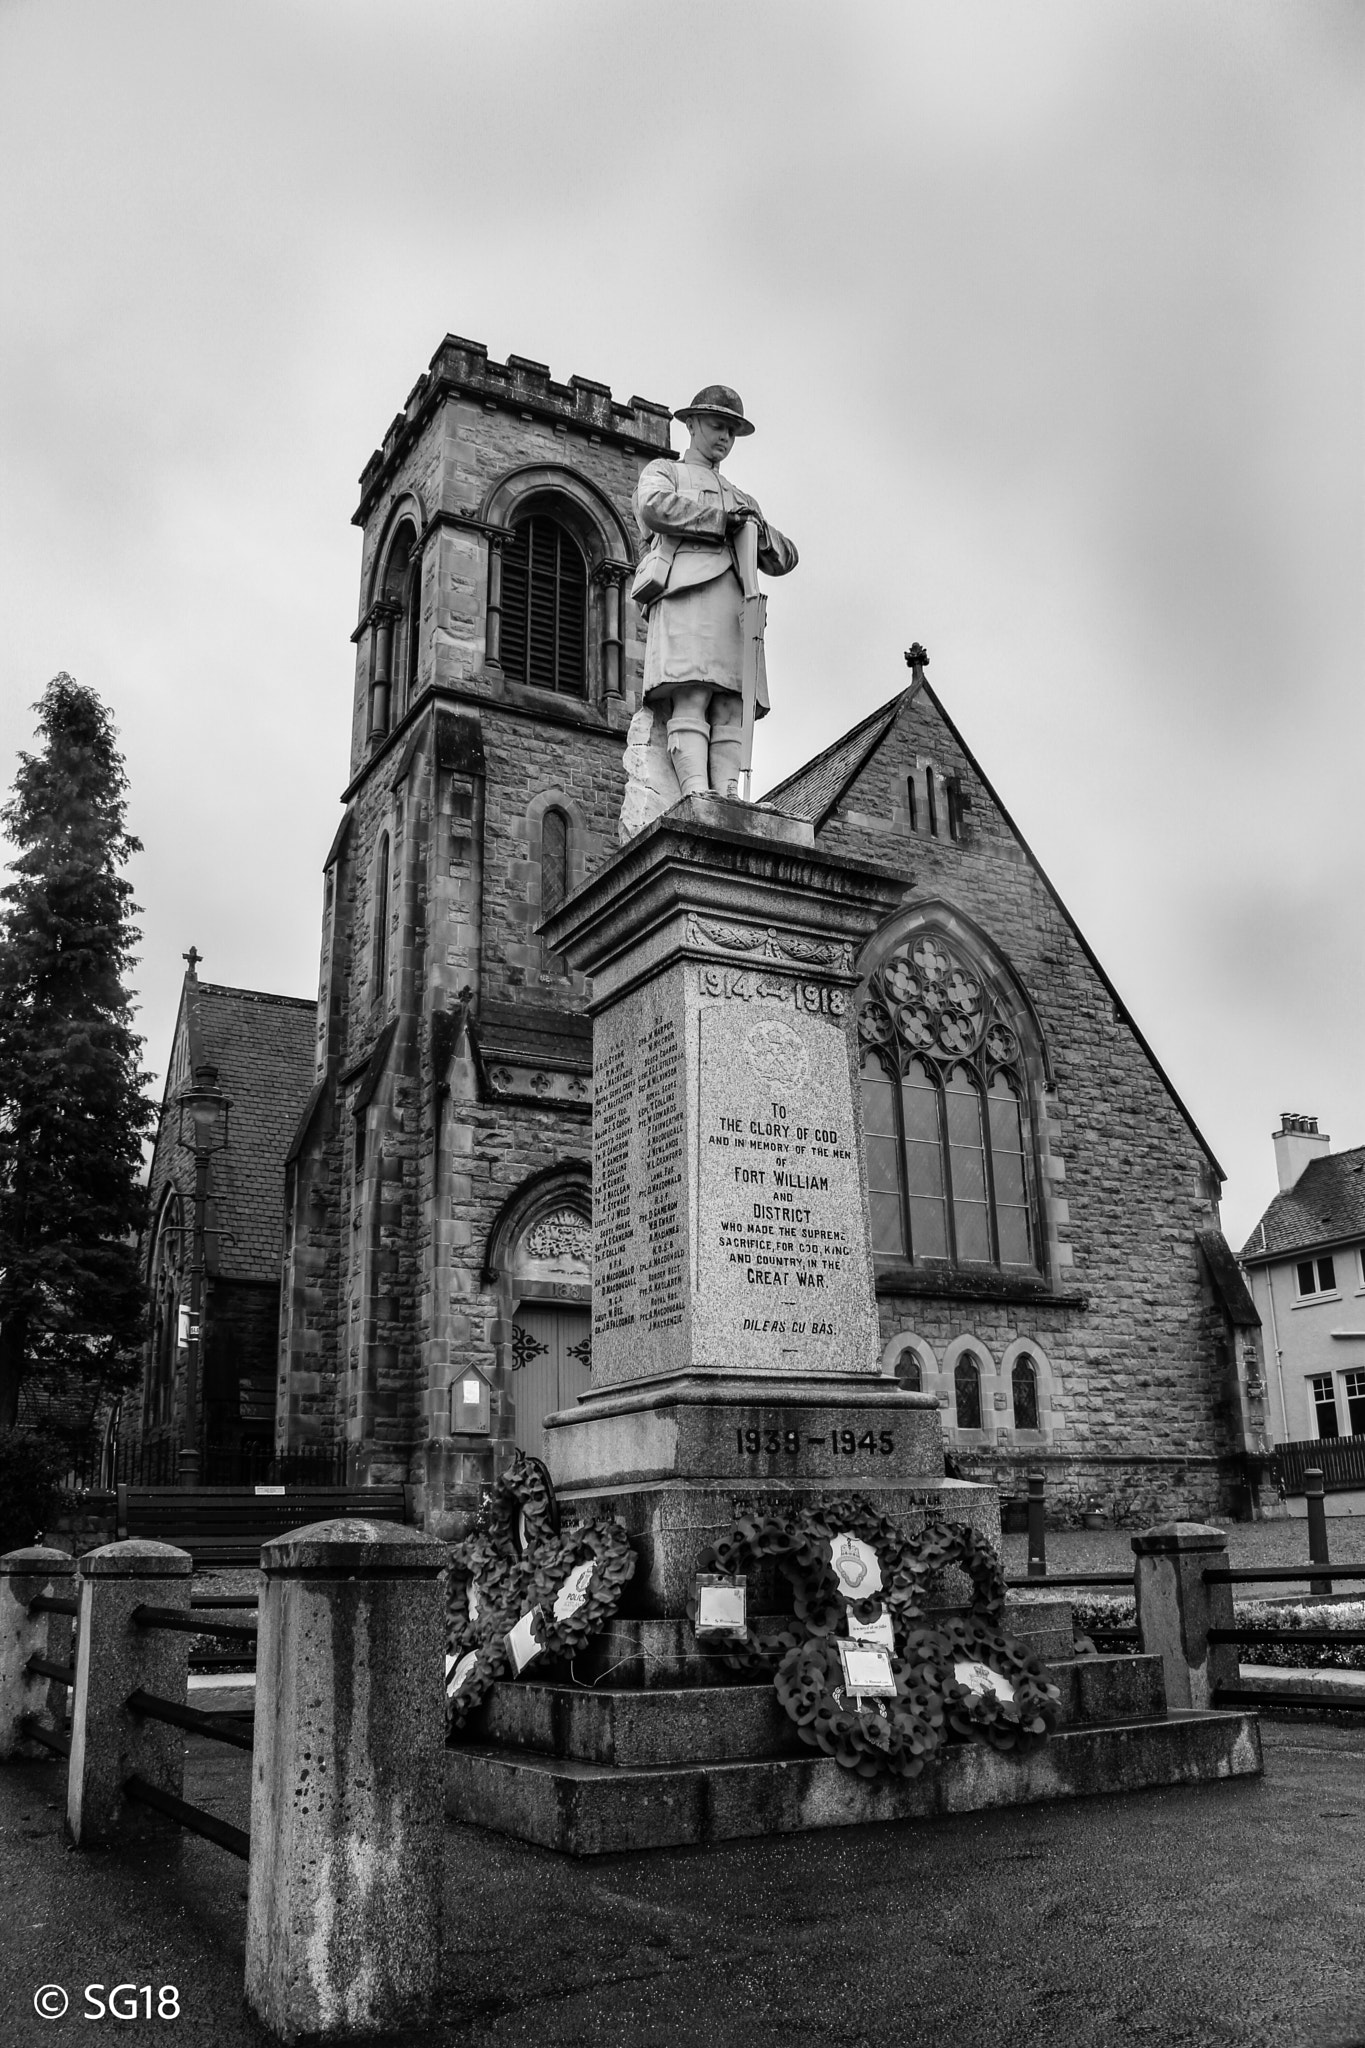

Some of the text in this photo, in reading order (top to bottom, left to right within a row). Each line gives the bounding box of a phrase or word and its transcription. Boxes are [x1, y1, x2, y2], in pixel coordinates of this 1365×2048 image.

[699, 968, 845, 1017] 1914 1918
[771, 1102, 787, 1119] TO
[720, 1117, 837, 1144] THE GLORY OF GOD
[708, 1135, 851, 1160] AND IN MEMORY OF THE MEN
[776, 1157, 787, 1168] OF
[735, 1166, 828, 1191] FORT WILLIAM
[773, 1192, 793, 1202] AND
[753, 1203, 811, 1224] DISTRICT
[721, 1221, 846, 1241] WHO MADE THE SUPREME
[776, 1242, 794, 1252] FOR
[824, 1245, 850, 1256] KING
[729, 1253, 751, 1264] AND
[807, 1259, 817, 1268] IN
[822, 1260, 841, 1271] THE
[747, 1268, 829, 1289] GREAT WAR.
[743, 1319, 786, 1333] DILEAS
[566, 1593, 585, 1602] POLIC
